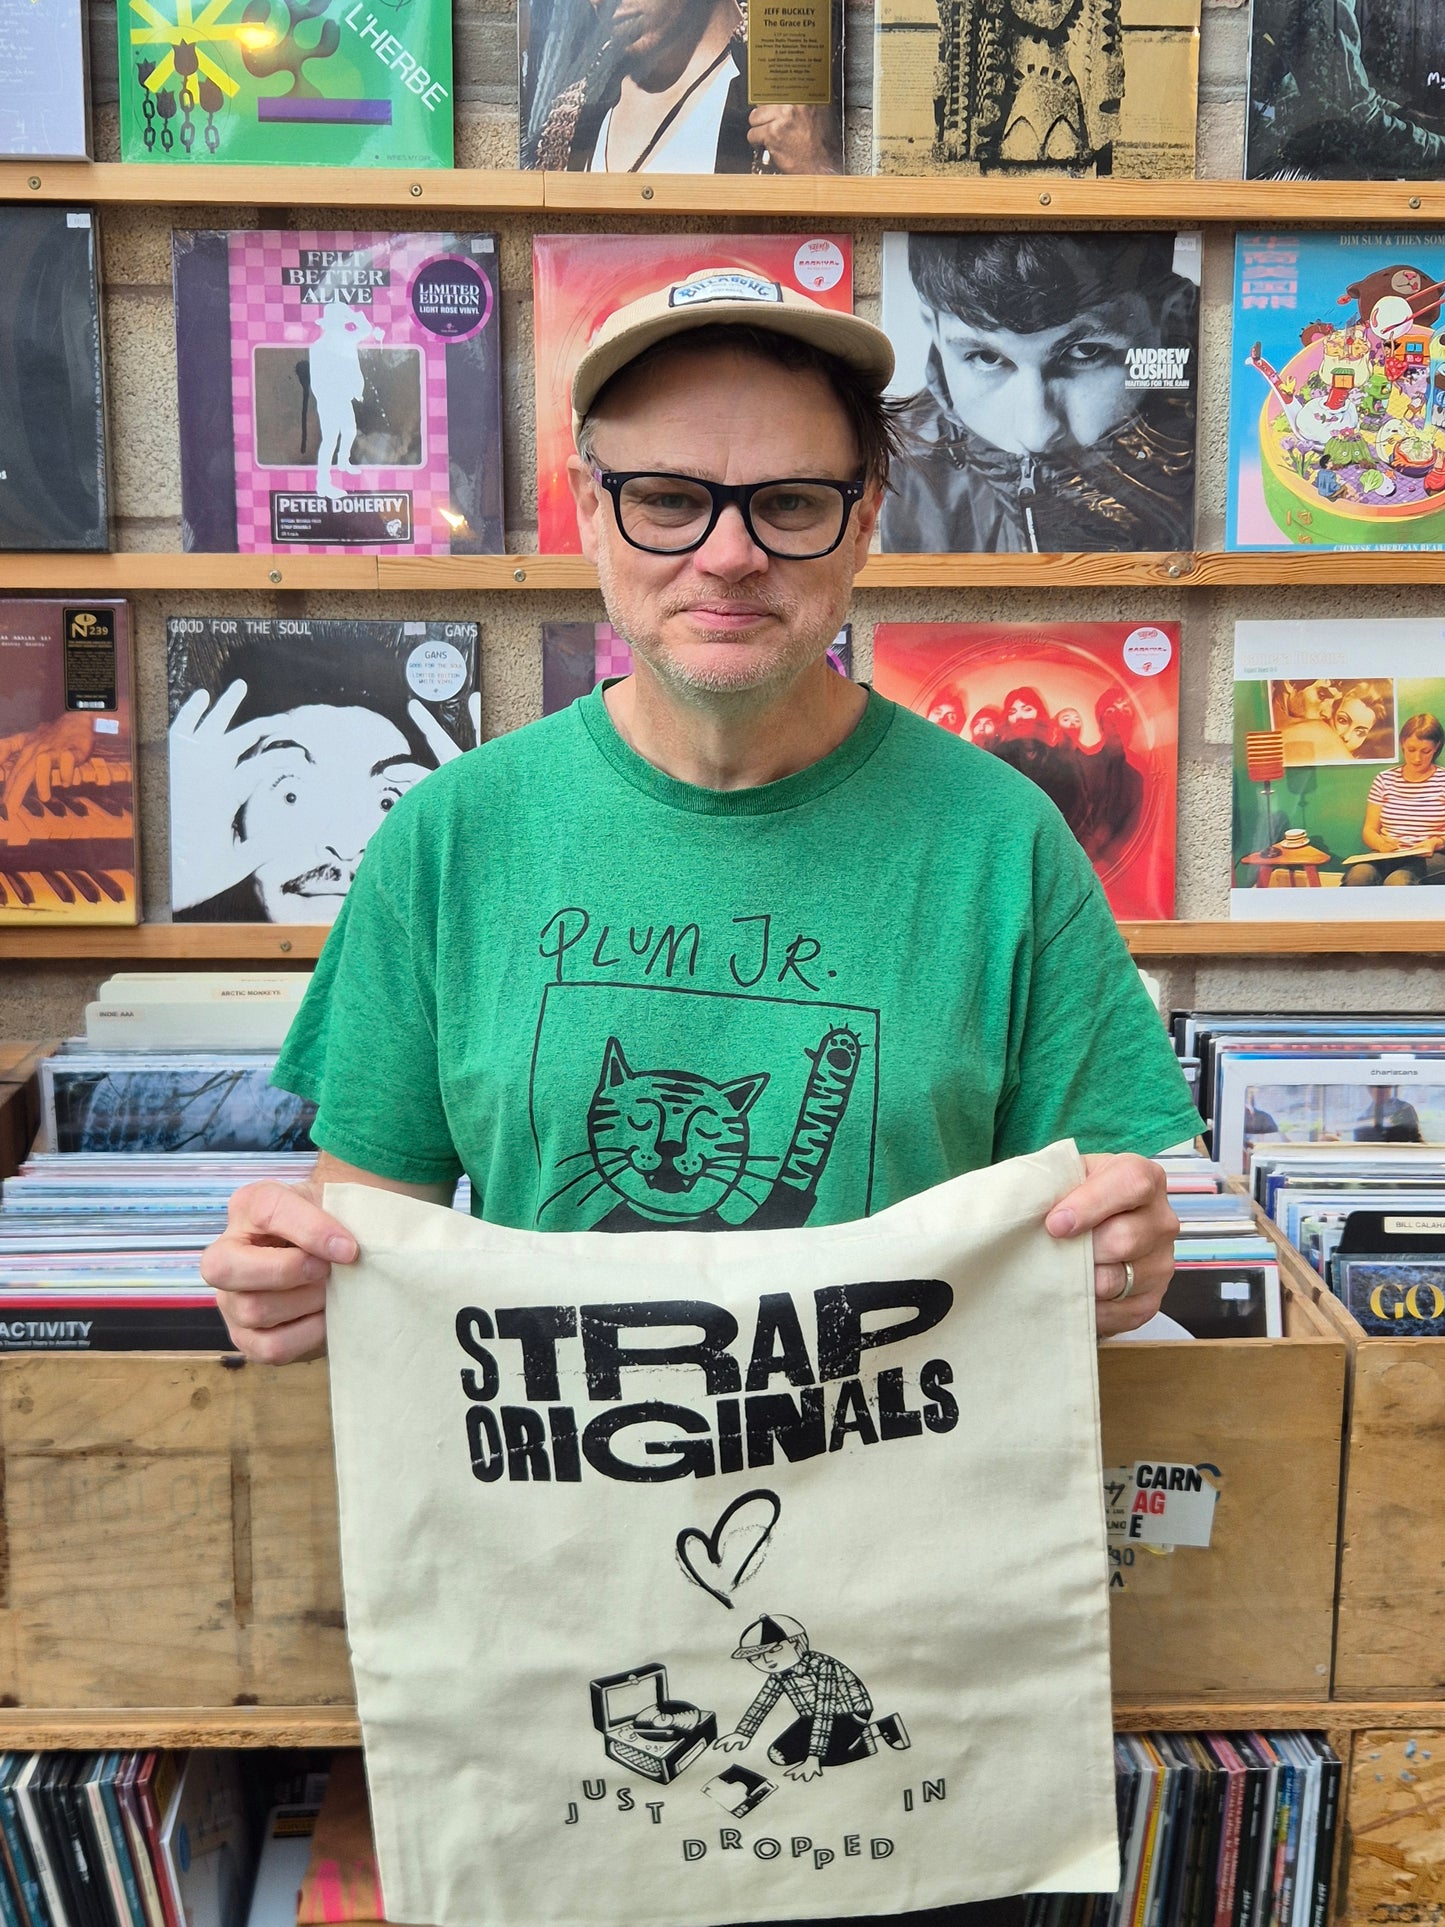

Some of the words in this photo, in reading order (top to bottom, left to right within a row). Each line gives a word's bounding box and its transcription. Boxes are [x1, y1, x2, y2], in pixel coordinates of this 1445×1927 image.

[764, 7, 779, 15] JEFF
[781, 7, 816, 15] BUCKLEY
[764, 19, 777, 27] The
[780, 19, 801, 27] Grace
[344, 2, 449, 112] L'HERBE
[1340, 235, 1359, 246] DIM
[1362, 235, 1382, 246] SUM
[1385, 235, 1392, 246] &
[1395, 235, 1421, 246] THEN
[307, 251, 365, 267] FELT
[288, 269, 384, 286] BETTER
[302, 287, 373, 303] ALIVE
[419, 284, 480, 295] LIMITED
[679, 276, 772, 298] BILLABONG
[419, 294, 480, 305] EDITION
[419, 306, 439, 314] LIGHT
[440, 306, 459, 314] ROSE
[459, 306, 480, 315] VINYL
[1124, 348, 1191, 365] ANDREW
[1129, 363, 1184, 380] CUSHIN
[279, 498, 328, 513] PETER
[331, 497, 403, 513] DOHERTY
[89, 626, 109, 636] 239
[170, 620, 204, 634] GOOD
[212, 621, 238, 634] FOR
[245, 621, 270, 634] THE
[279, 621, 312, 635] SOUL
[445, 624, 478, 638] GANS
[424, 650, 448, 659] GANS
[538, 906, 700, 982] PLUM
[729, 914, 839, 992] JR.
[0, 1321, 93, 1338] ACTIVITY
[455, 1278, 954, 1402] STRAP
[464, 1358, 960, 1483] ORIGINALS
[1136, 1464, 1203, 1492] CARN
[1131, 1489, 1167, 1515] AG
[1129, 1514, 1144, 1538] E
[564, 1778, 666, 1825] JUST
[682, 1828, 895, 1870] DROPPED
[903, 1778, 947, 1812] IN
